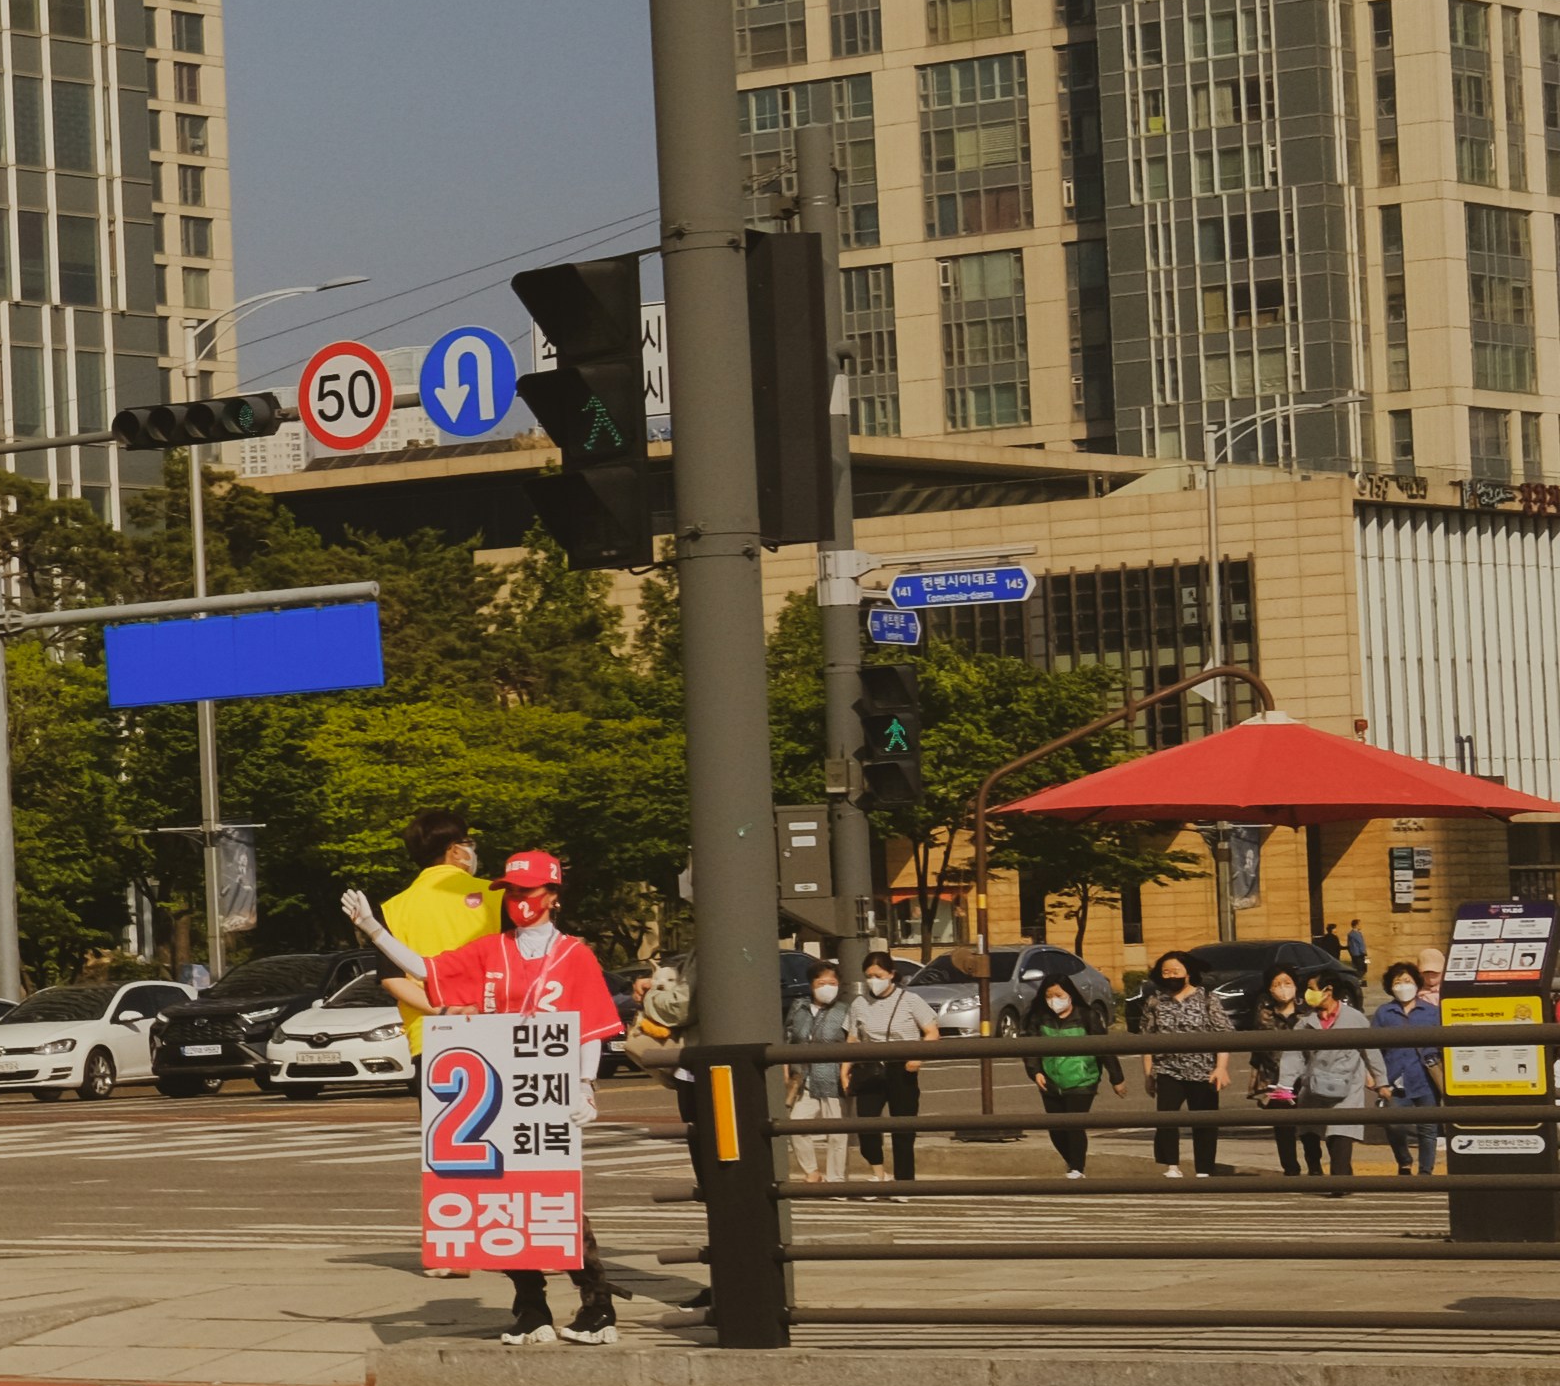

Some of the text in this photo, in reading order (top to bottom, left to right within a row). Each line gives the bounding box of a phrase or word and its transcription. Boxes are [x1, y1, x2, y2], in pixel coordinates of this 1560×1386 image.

[317, 368, 376, 423] 50
[895, 586, 912, 598] 141
[1005, 578, 1025, 591] 145
[518, 900, 536, 919] 2
[512, 1023, 570, 1055] 민생
[511, 1071, 571, 1108] 경제
[424, 1046, 504, 1180] 2
[511, 1121, 573, 1157] 회복
[425, 1190, 579, 1258] 유정복
